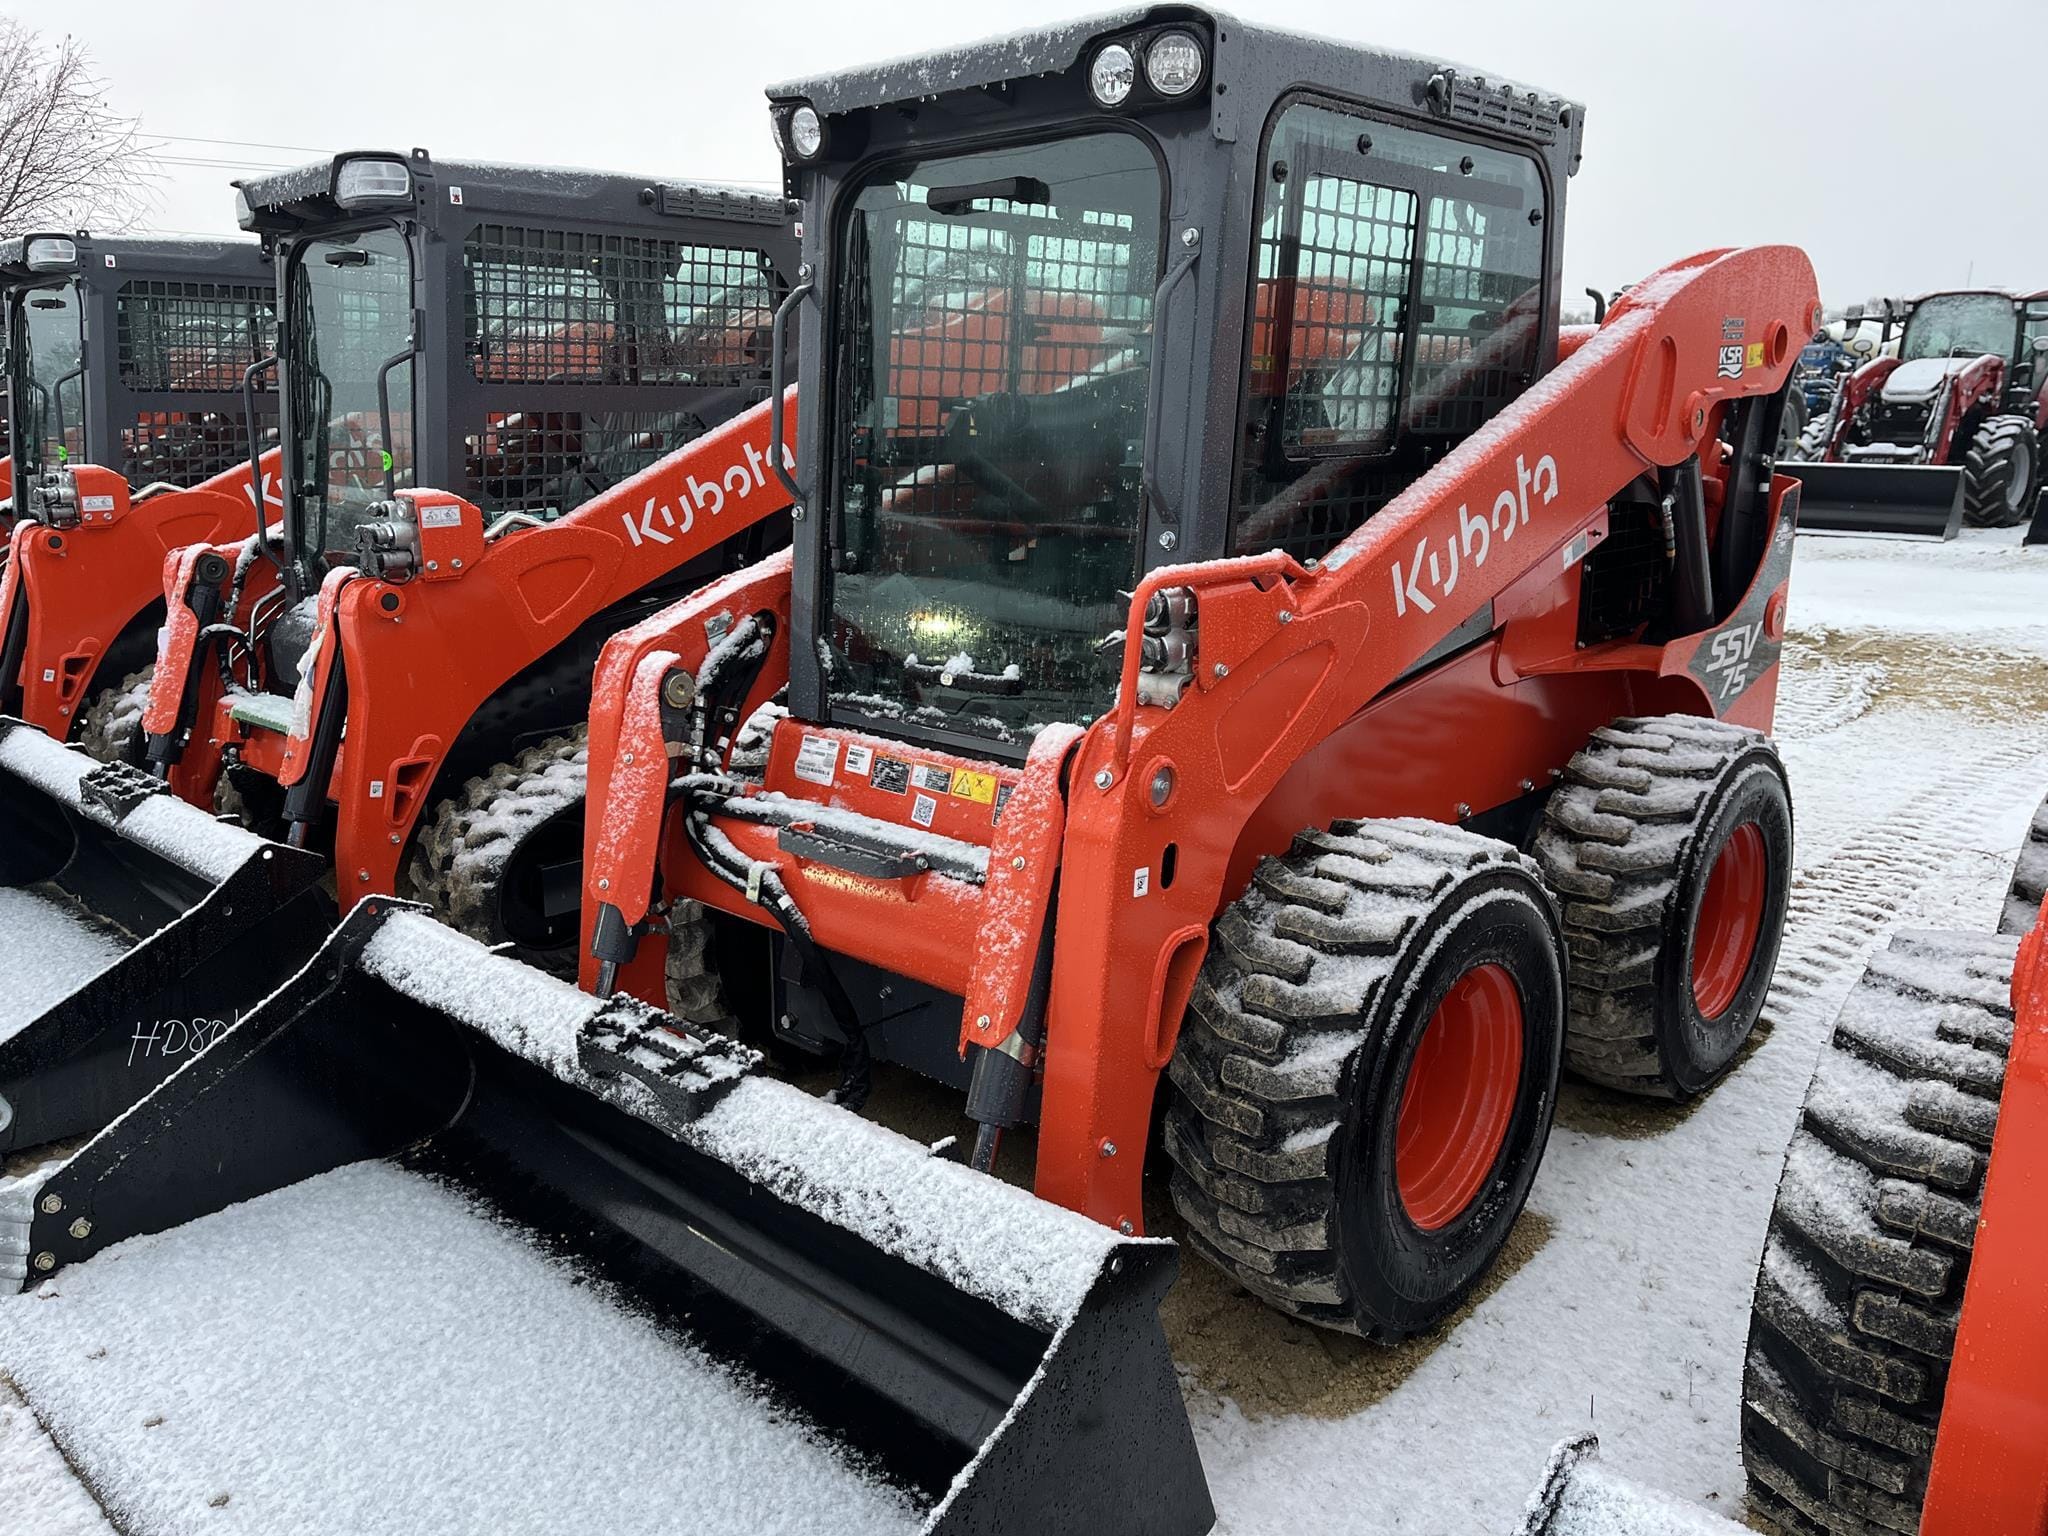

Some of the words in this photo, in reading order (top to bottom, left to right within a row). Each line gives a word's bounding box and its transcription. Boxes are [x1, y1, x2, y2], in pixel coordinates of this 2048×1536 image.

[1719, 346, 1743, 364] KSR
[622, 442, 796, 547] Kubota
[1391, 454, 1559, 618] Kubota
[1706, 620, 1763, 673] SSV
[1720, 662, 1749, 699] 75
